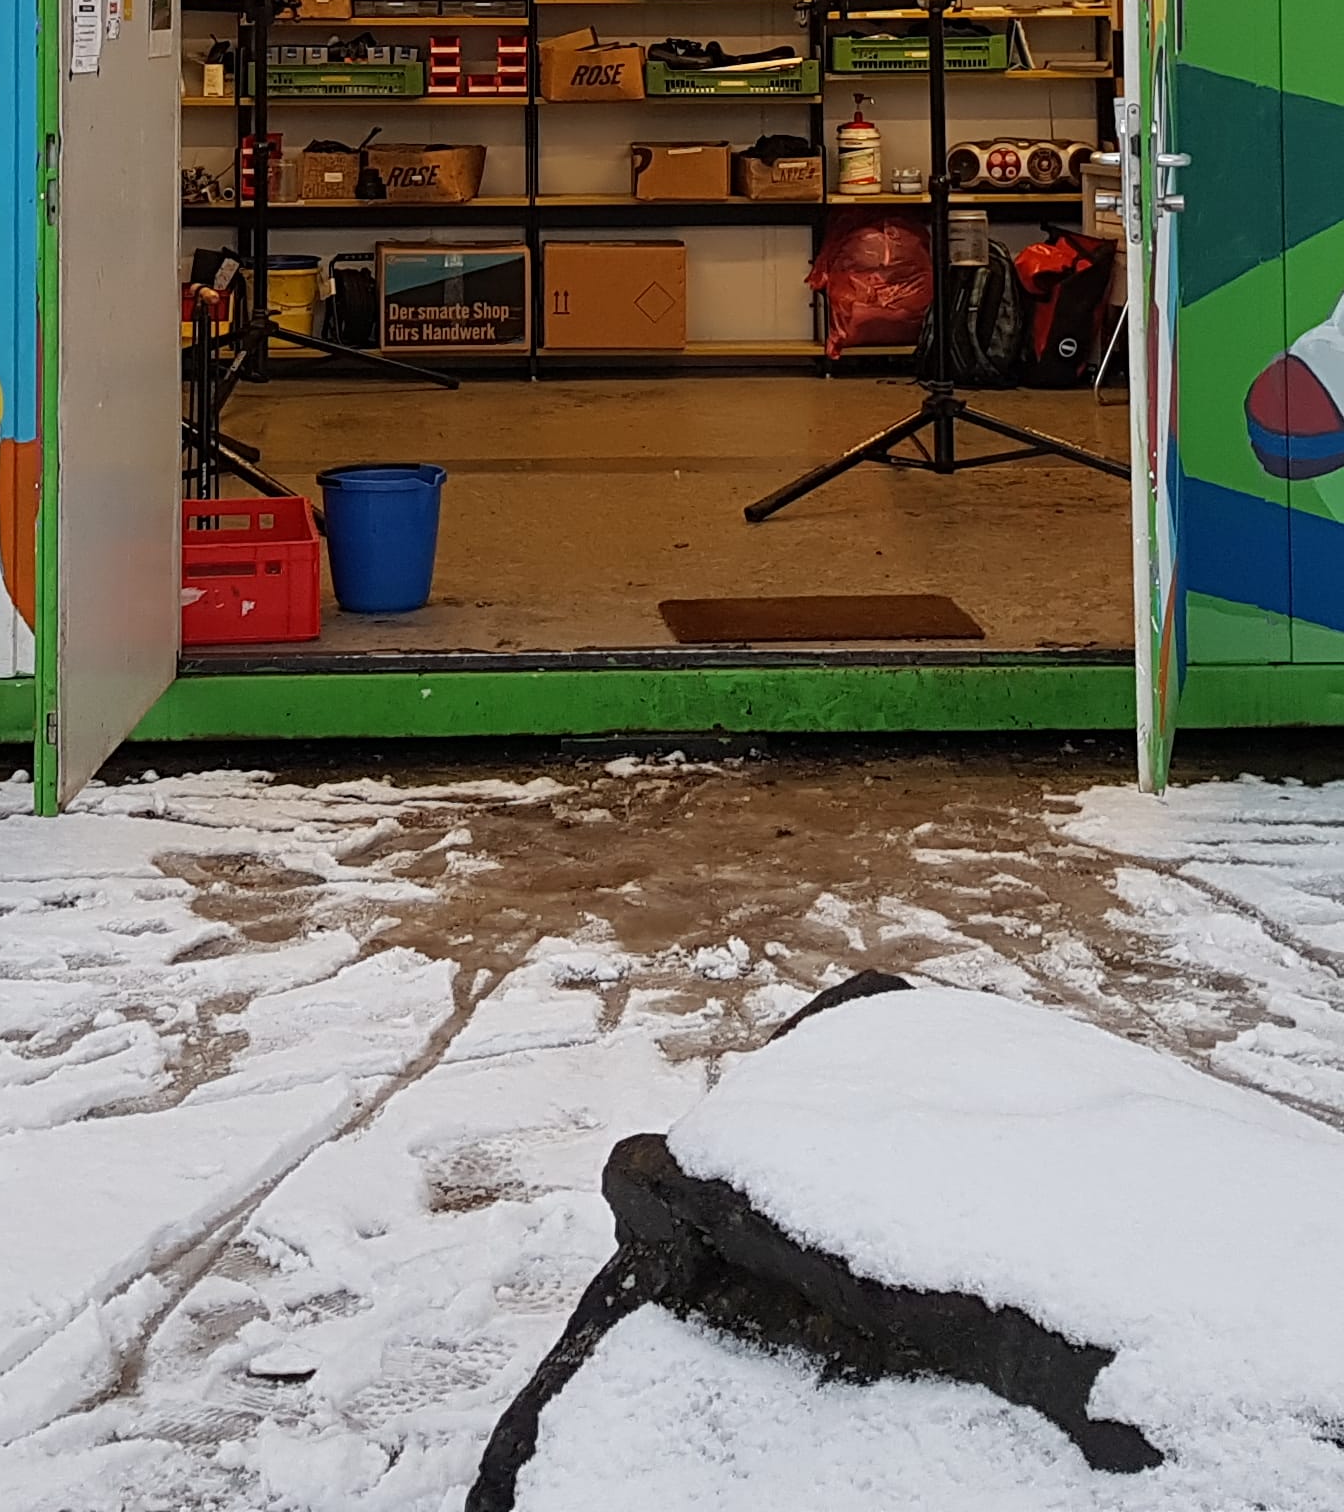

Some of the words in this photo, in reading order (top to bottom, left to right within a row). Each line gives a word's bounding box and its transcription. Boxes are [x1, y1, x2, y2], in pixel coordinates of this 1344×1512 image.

[570, 63, 625, 86] ROSE
[386, 165, 440, 187] ROSE
[389, 303, 414, 320] Der
[417, 305, 470, 320] smarte
[473, 302, 509, 322] Shop
[389, 324, 419, 341] fürs
[422, 323, 496, 341] Handwerk
